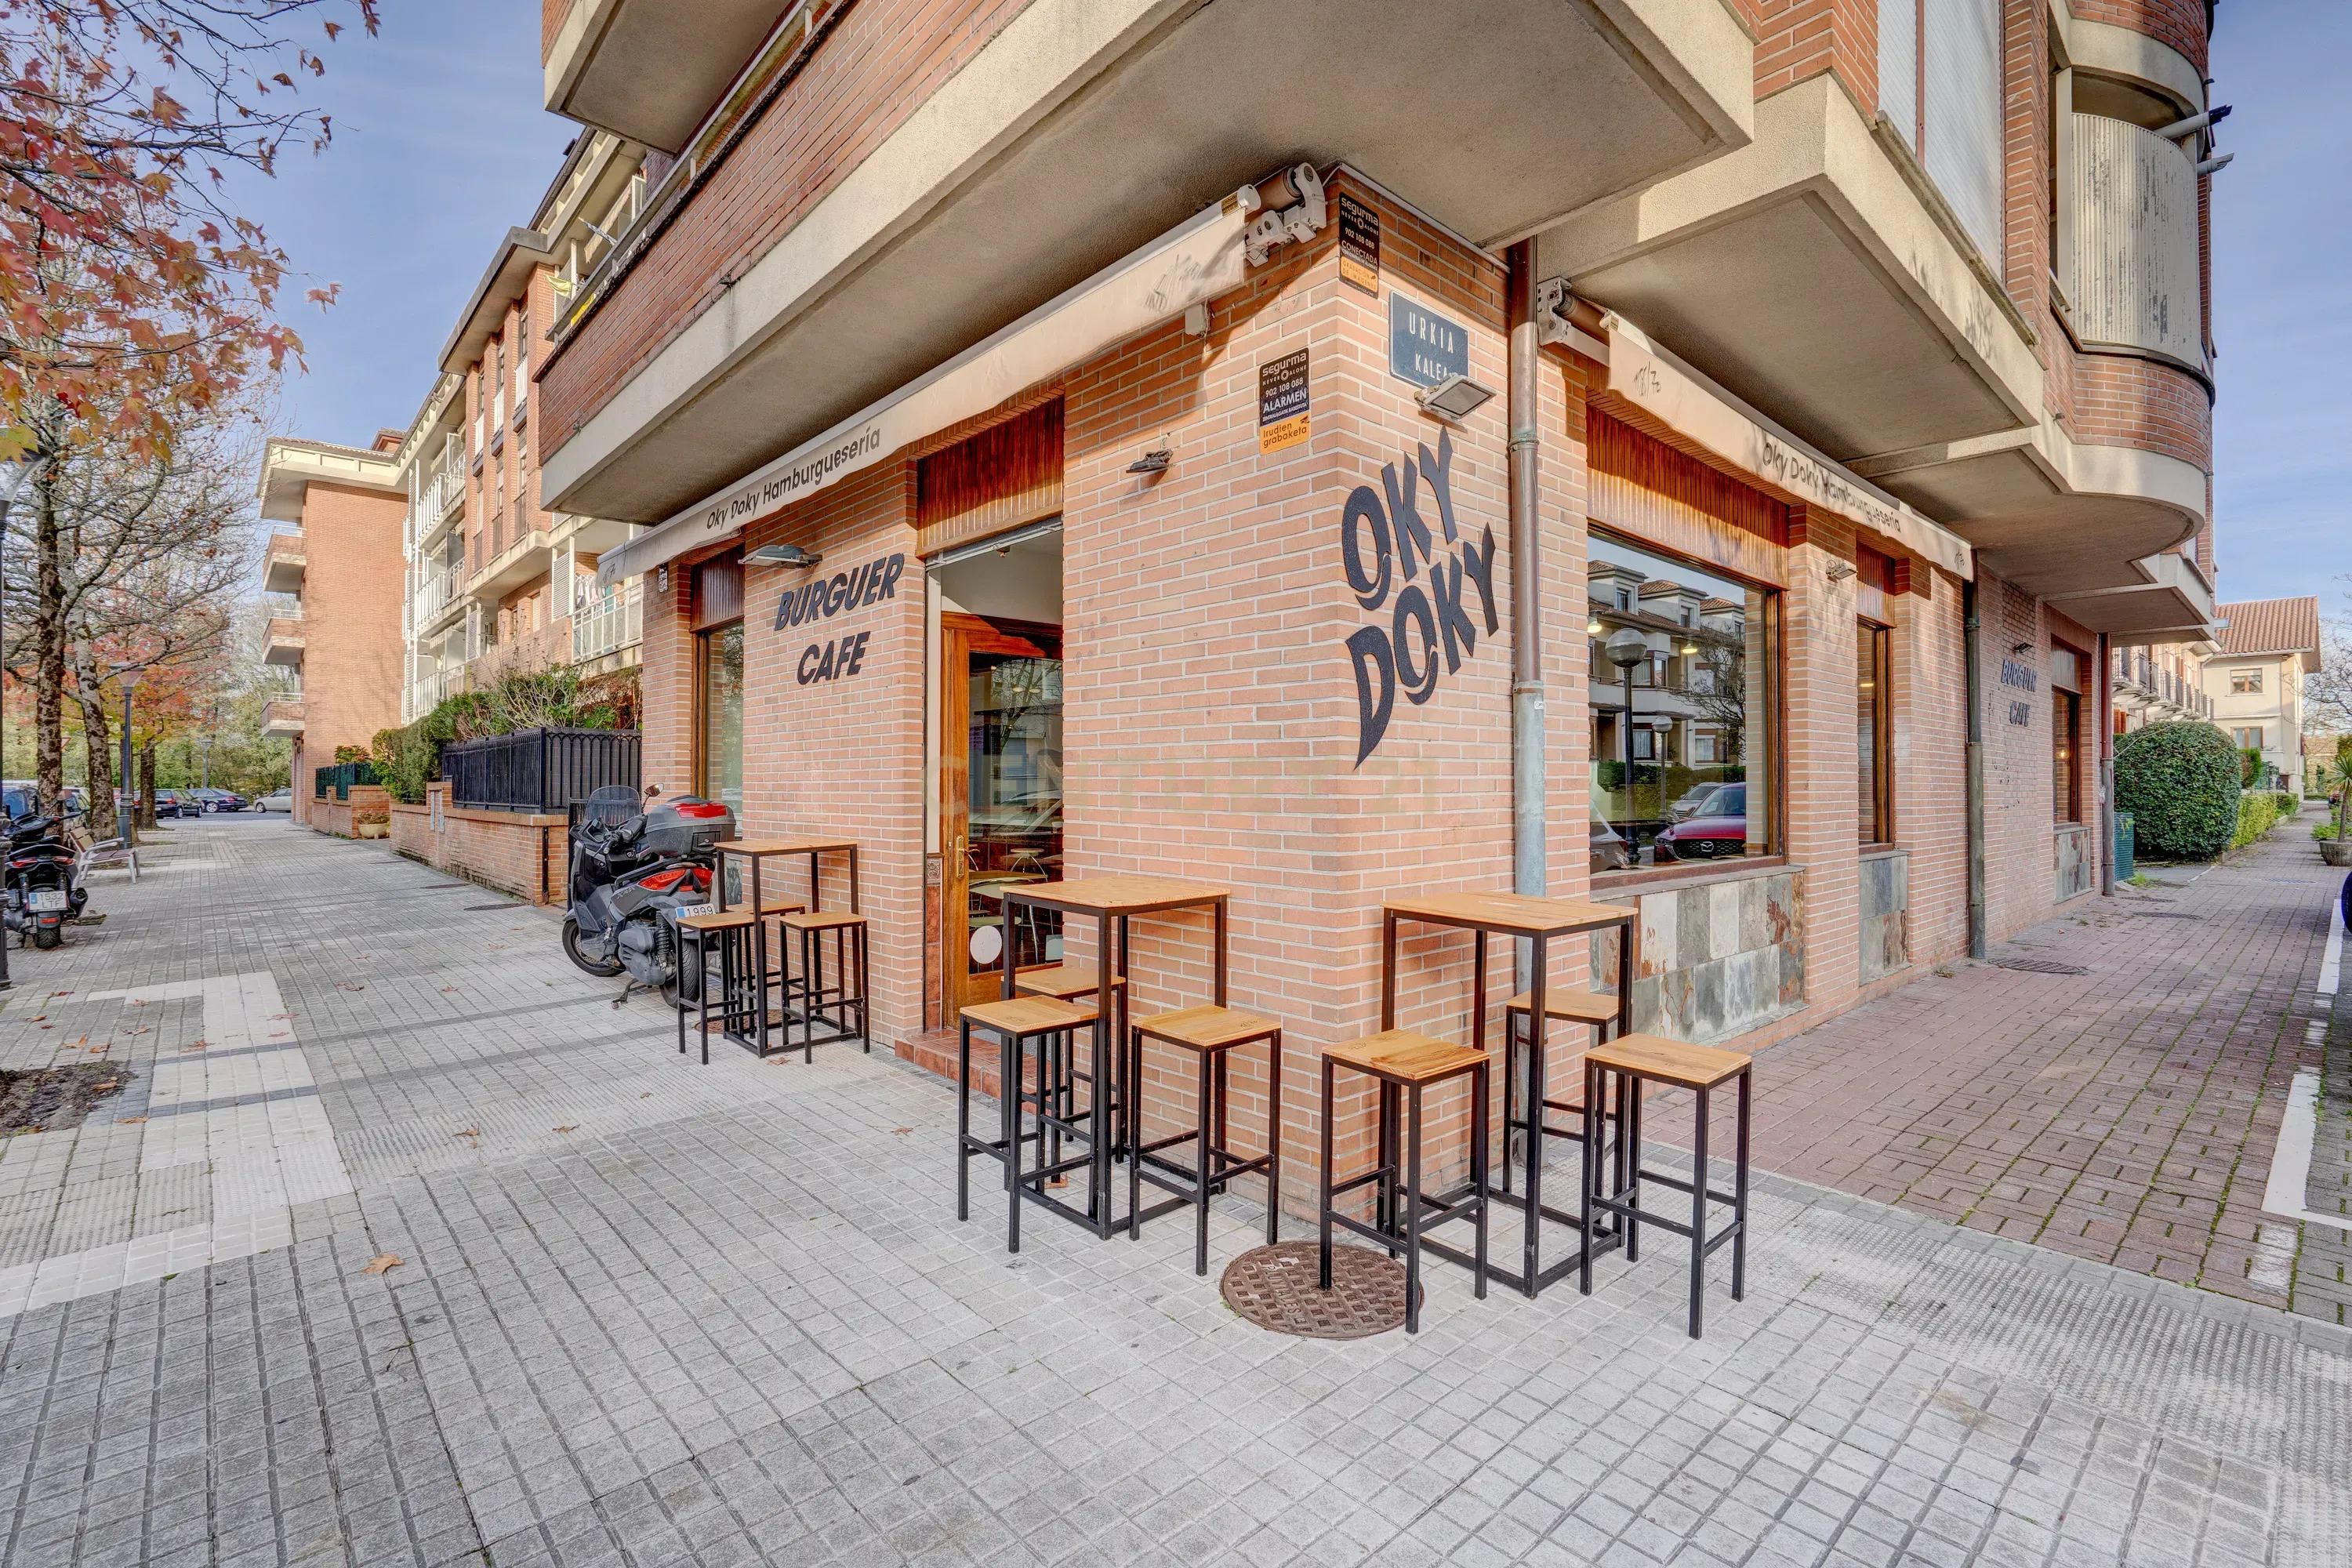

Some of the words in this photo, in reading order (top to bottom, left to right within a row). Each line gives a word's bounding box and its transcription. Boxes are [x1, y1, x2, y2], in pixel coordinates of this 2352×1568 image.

[1341, 198, 1378, 227] segurma
[1341, 210, 1356, 223] NEVER
[1365, 224, 1378, 235] ALONE
[1345, 227, 1355, 238] 902
[1356, 233, 1365, 244] 108
[1365, 238, 1375, 249] 088
[1341, 240, 1377, 266] CONECTADA
[1410, 311, 1454, 354] URKIA
[1262, 352, 1307, 376] segurma
[1262, 375, 1280, 386] NEVER
[1289, 365, 1307, 376] ALONE
[1415, 354, 1448, 381] KALEA
[1265, 387, 1277, 397] 902
[1279, 382, 1290, 393] 108
[1291, 377, 1304, 388] 088
[1263, 387, 1307, 414] ALARMEN
[1263, 423, 1292, 438] Irudien
[1263, 426, 1307, 448] grabaketa
[706, 506, 729, 530] Oky
[731, 491, 760, 519] Doky
[763, 425, 880, 504] Hamburguesería
[1762, 442, 1788, 481] Oky
[1791, 457, 1818, 497] Doky
[1342, 424, 1458, 611] OKY
[774, 553, 905, 631] BURGUER
[797, 631, 871, 685] CAFE
[1345, 521, 1499, 771] DOKY
[2001, 659, 2038, 692] BURGUER
[2009, 701, 2031, 727] CAFE
[39, 892, 64, 901] 1532
[42, 899, 60, 909] LTF
[686, 906, 713, 917] 1999
